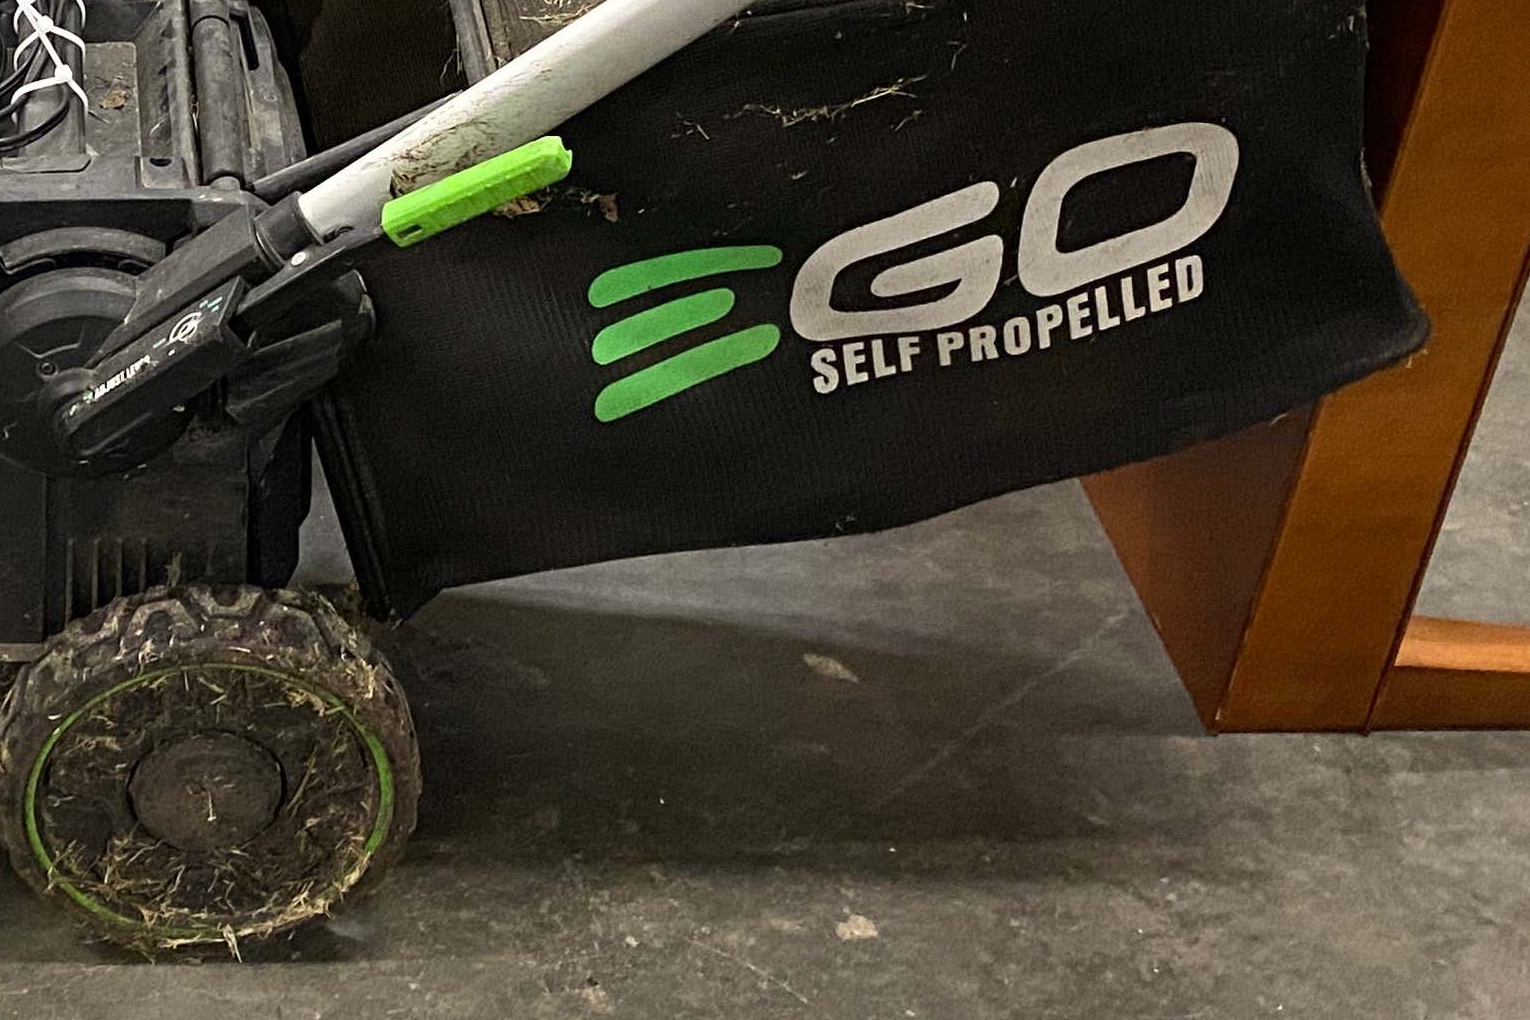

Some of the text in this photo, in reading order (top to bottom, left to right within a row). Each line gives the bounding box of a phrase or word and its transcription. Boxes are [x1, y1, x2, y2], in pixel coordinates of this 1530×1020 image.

[588, 122, 1239, 423] EGO
[810, 255, 1205, 395] SELF PROPELLED
